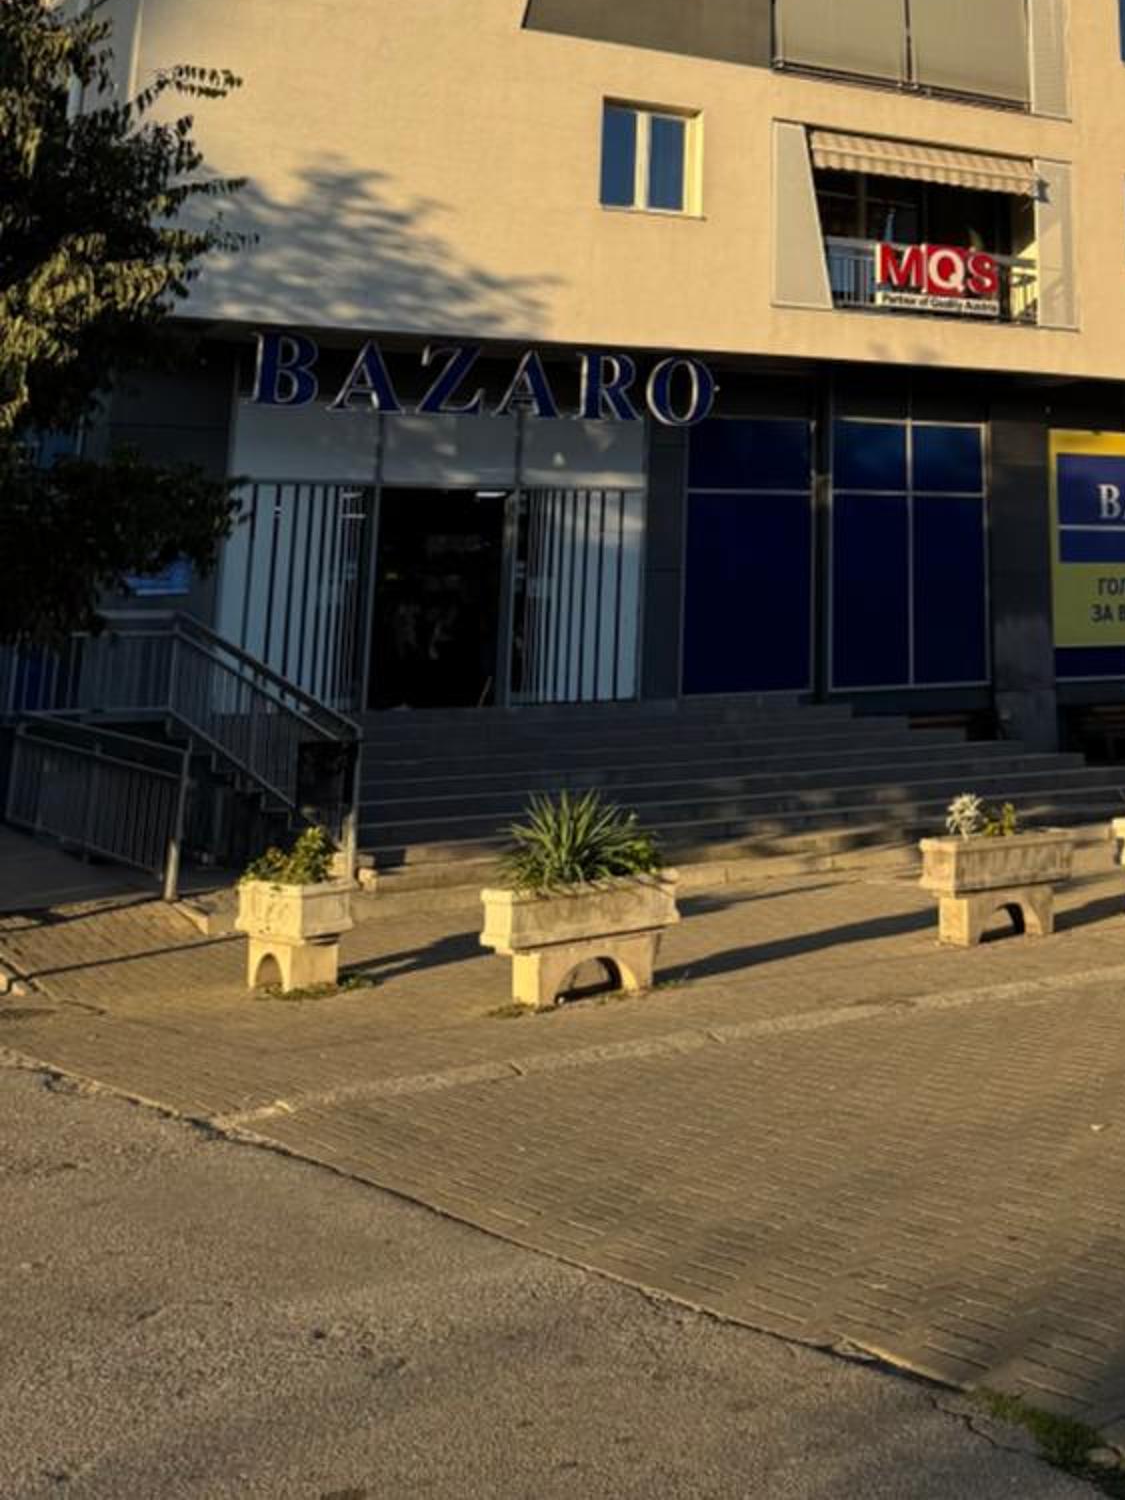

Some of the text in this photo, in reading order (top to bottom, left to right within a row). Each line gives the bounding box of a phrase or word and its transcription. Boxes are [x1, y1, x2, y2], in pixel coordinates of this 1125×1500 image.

[876, 243, 998, 295] MQS
[252, 330, 716, 427] BAZARO
[1091, 603, 1113, 622] ЗА
